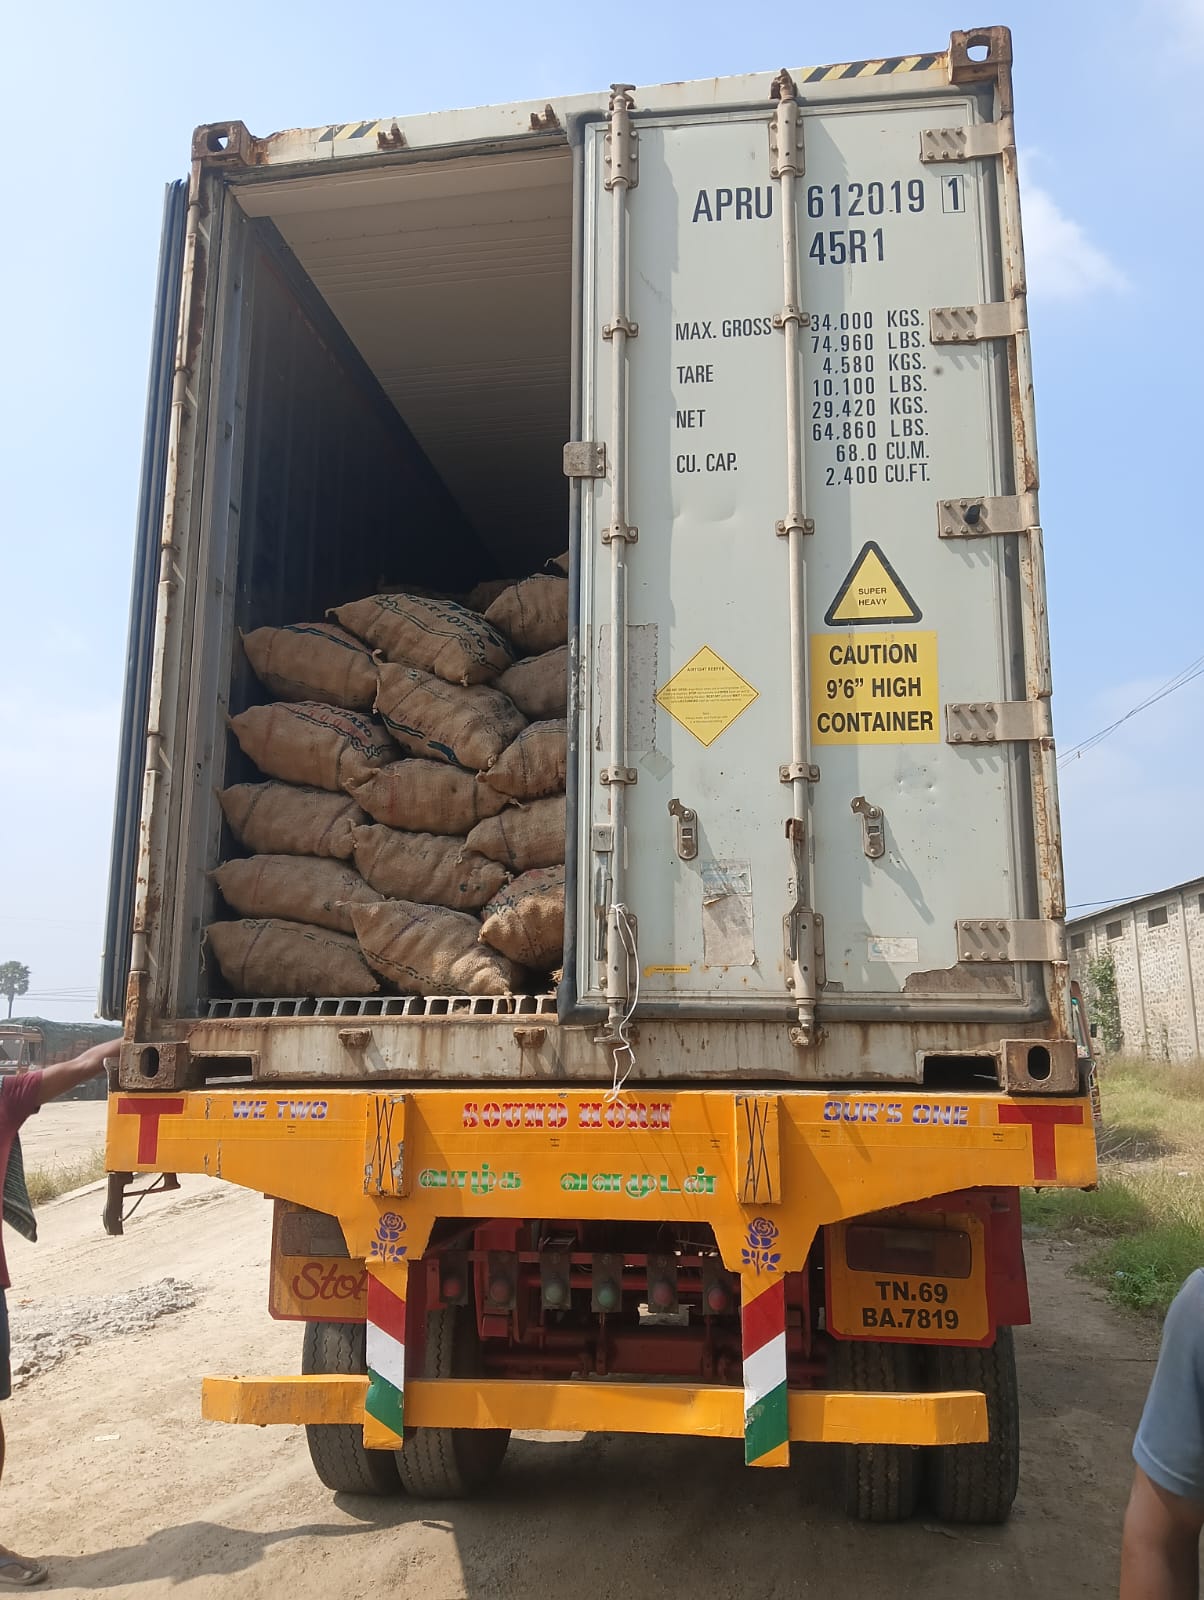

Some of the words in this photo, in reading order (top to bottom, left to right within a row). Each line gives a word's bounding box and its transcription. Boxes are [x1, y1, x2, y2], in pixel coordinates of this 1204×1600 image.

[692, 186, 773, 223] APRU
[806, 179, 925, 219] 612019
[808, 228, 885, 266] 45R1
[675, 322, 717, 341] MAX.
[722, 317, 772, 338] GROSS
[887, 309, 925, 327] KGS.
[887, 331, 926, 349] LBS.
[677, 364, 714, 384] TARE
[888, 352, 927, 371] KGS.
[889, 374, 928, 393] LBS.
[676, 409, 706, 429] NET
[890, 396, 928, 415] KGS.
[890, 418, 929, 437] LBS.
[676, 454, 701, 473] CU.
[706, 452, 738, 472] CAP.
[836, 442, 877, 463] 68.0
[886, 440, 930, 460] CU.M.
[885, 462, 930, 483] CU.FT.
[858, 587, 887, 595] SUPER
[858, 598, 887, 606] HEAVY
[829, 643, 918, 665] CAUTION
[871, 677, 922, 698] HIGH
[817, 711, 934, 733] CONTAINER
[232, 1100, 268, 1119] WE
[275, 1100, 328, 1120] TWO
[462, 1102, 569, 1129] SOUND
[578, 1102, 672, 1129] HORN
[912, 1103, 970, 1125] ONE
[875, 1281, 948, 1304] TN.69
[862, 1308, 959, 1330] BA.7819
